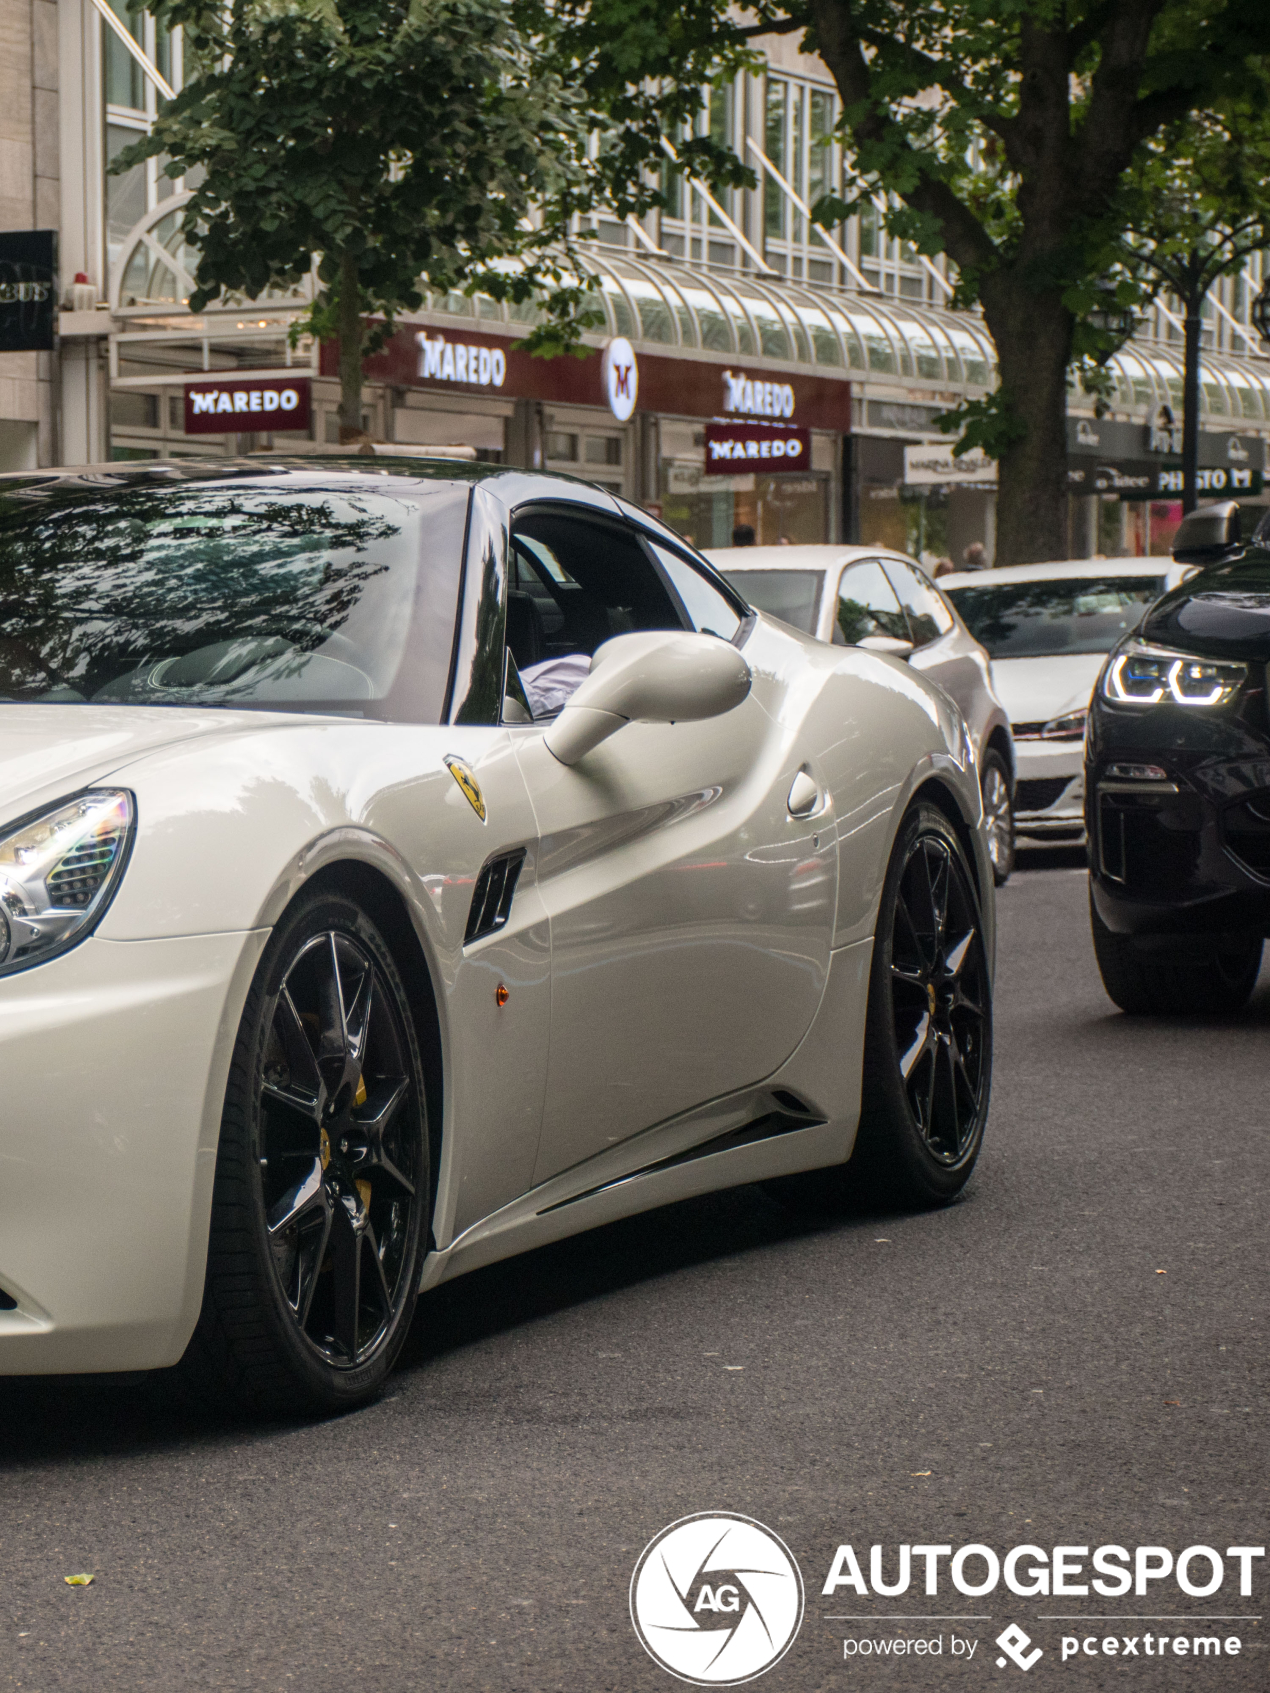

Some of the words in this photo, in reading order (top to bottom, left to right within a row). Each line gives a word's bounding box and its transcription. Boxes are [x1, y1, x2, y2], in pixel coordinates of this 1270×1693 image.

[414, 331, 507, 388] MAREDO
[189, 389, 299, 414] MAREDO
[721, 370, 796, 418] MAREDO
[708, 438, 803, 460] MAREDO
